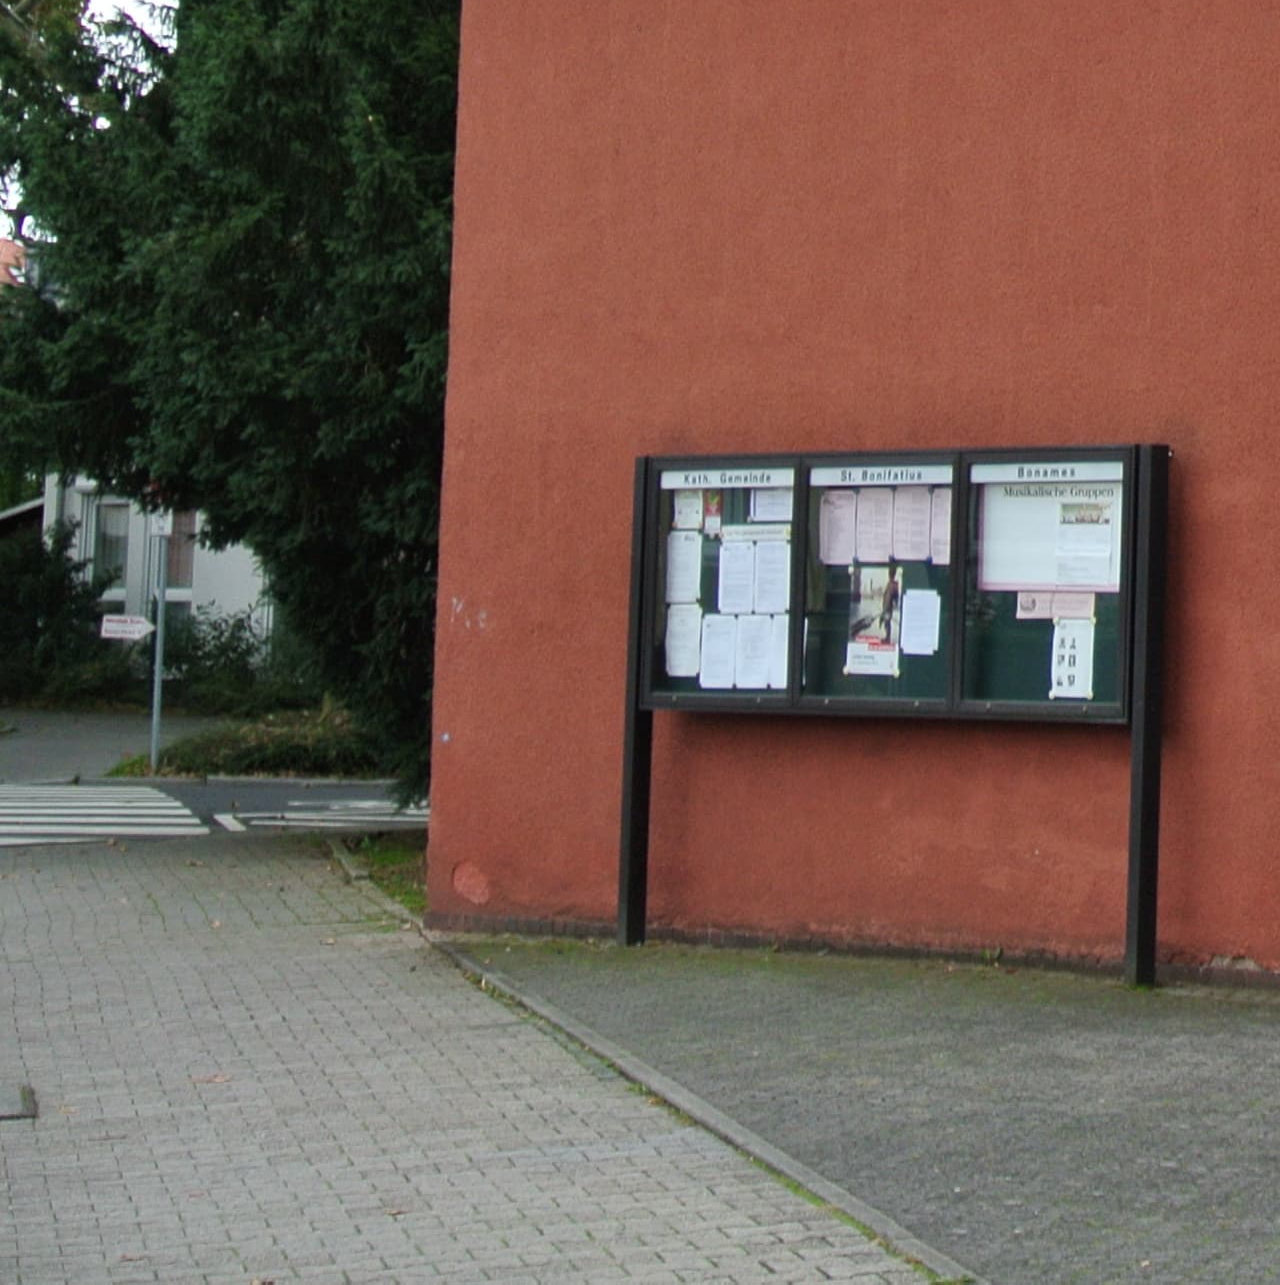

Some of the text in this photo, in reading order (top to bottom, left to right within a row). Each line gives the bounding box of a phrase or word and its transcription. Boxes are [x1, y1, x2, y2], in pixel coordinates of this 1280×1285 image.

[684, 472, 771, 484] Kath. Gemeinde
[841, 469, 922, 482] St. Bonifatius
[1018, 466, 1075, 478] Bonames
[1003, 484, 1114, 499] Musikalische Gruppen
